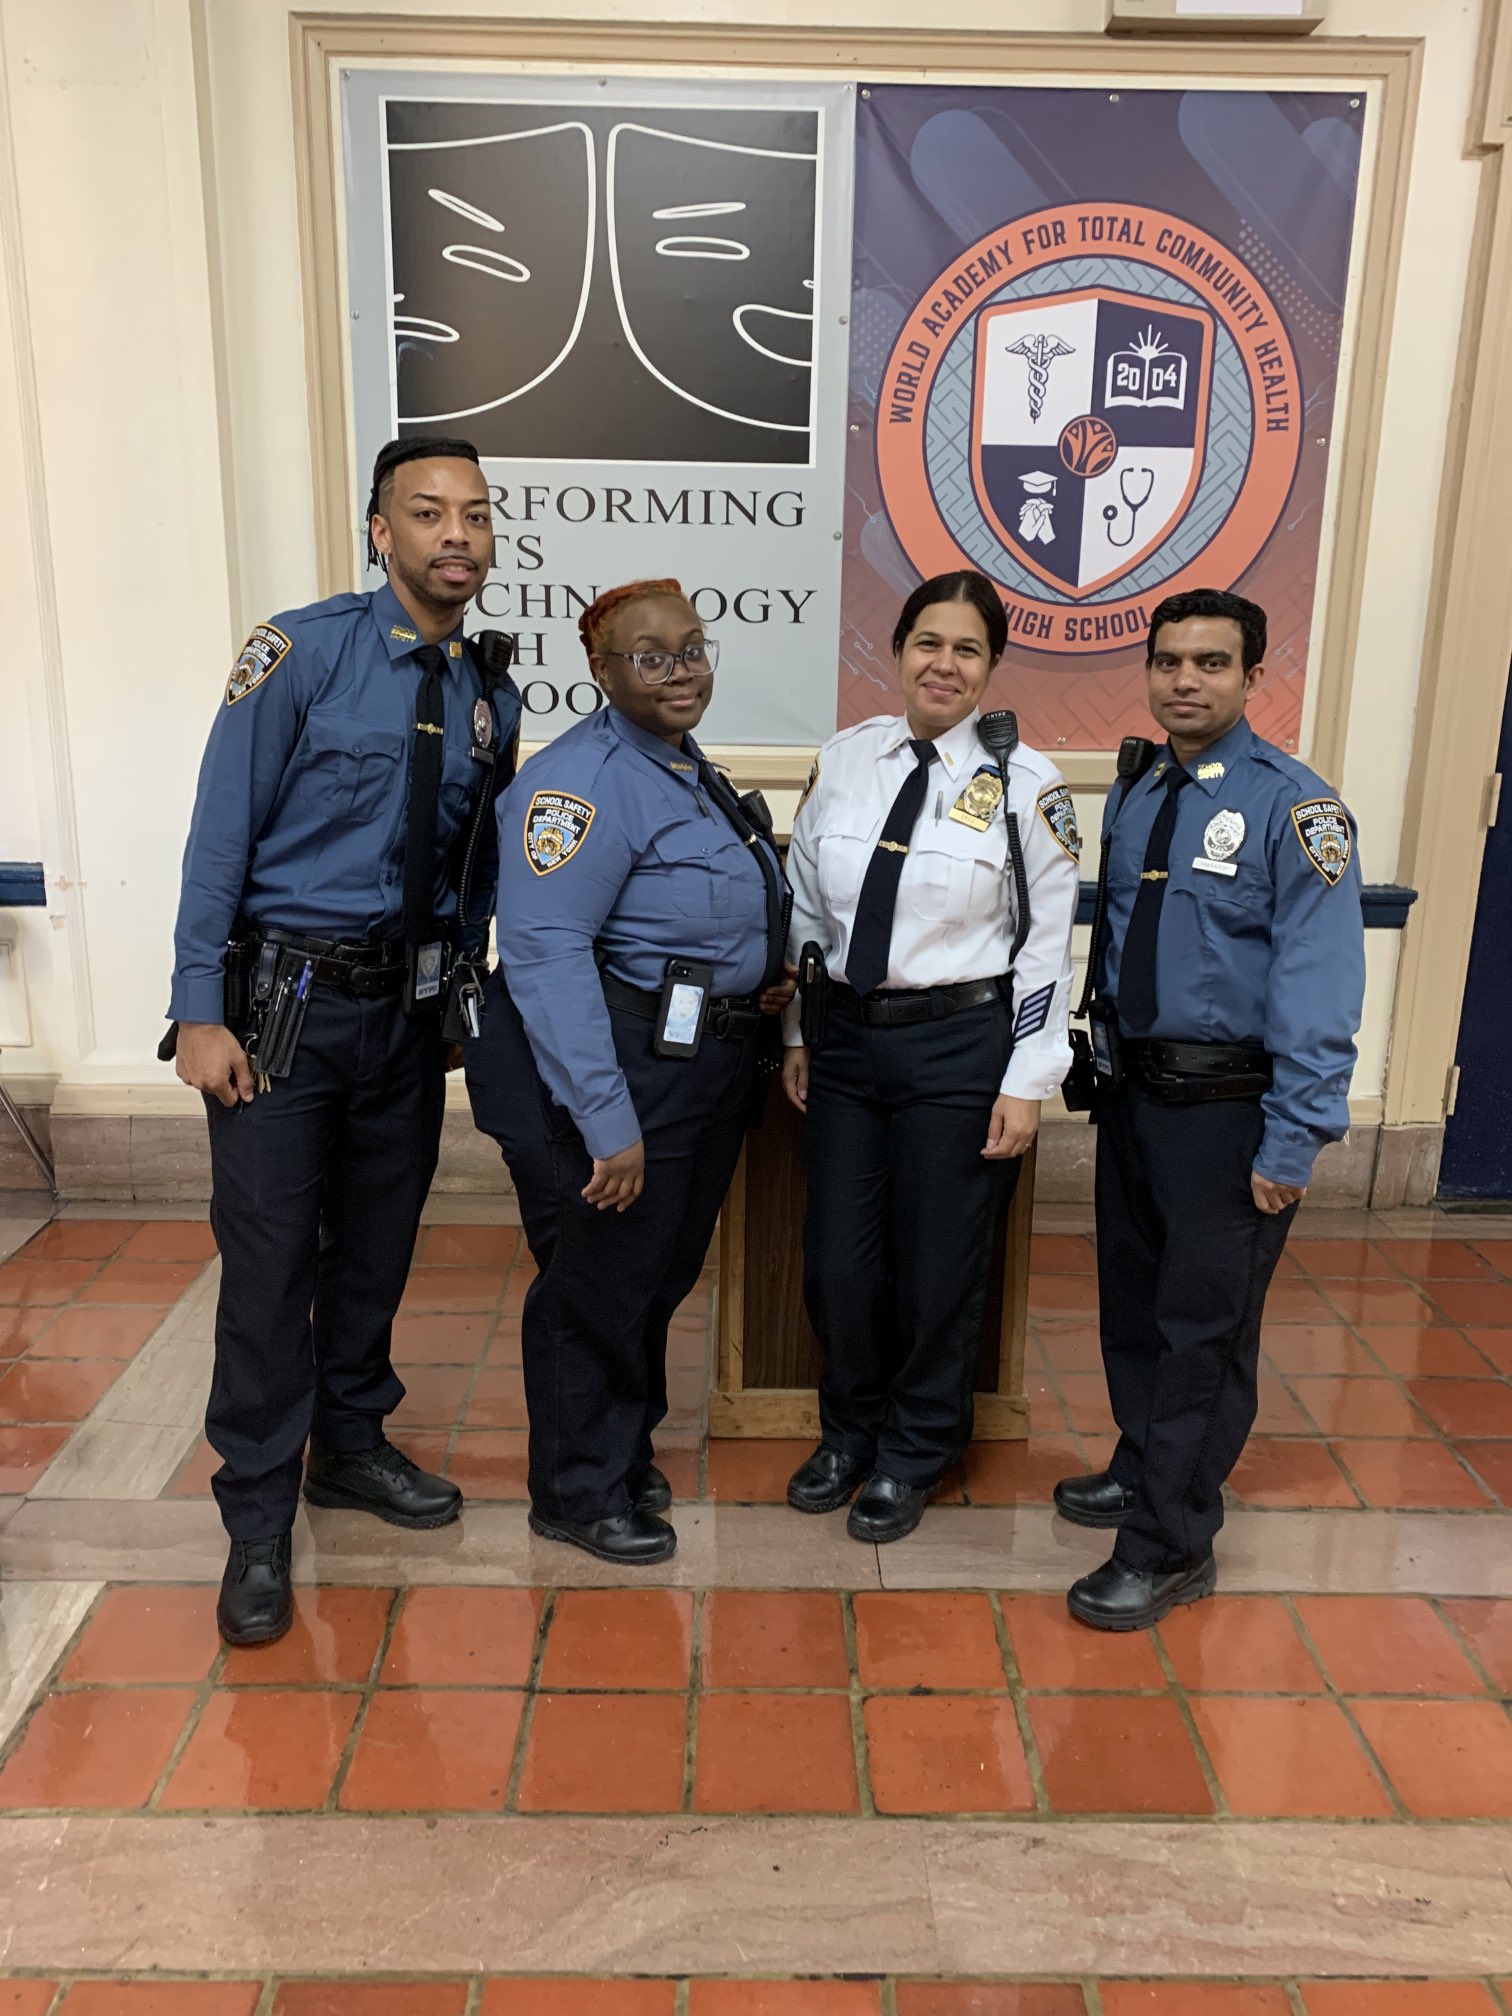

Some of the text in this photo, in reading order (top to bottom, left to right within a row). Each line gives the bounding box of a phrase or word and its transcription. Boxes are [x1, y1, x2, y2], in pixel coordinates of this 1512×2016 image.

[890, 216, 1289, 432] WORLD ACADEMY FOR TOTAL COMMUNITY HEALTH
[488, 485, 807, 527] RFORMING
[1065, 606, 1151, 641] SCHOOL
[535, 796, 592, 819] SCHOOL SAFETY
[1039, 790, 1059, 809] SCHOOL
[545, 808, 575, 823] POLICE
[1296, 804, 1323, 819] SCHOOL
[533, 815, 581, 834] DEPARTMENT
[1305, 823, 1345, 837] DEPARTMENT
[1313, 816, 1338, 827] POLICE
[562, 839, 578, 857] YORK
